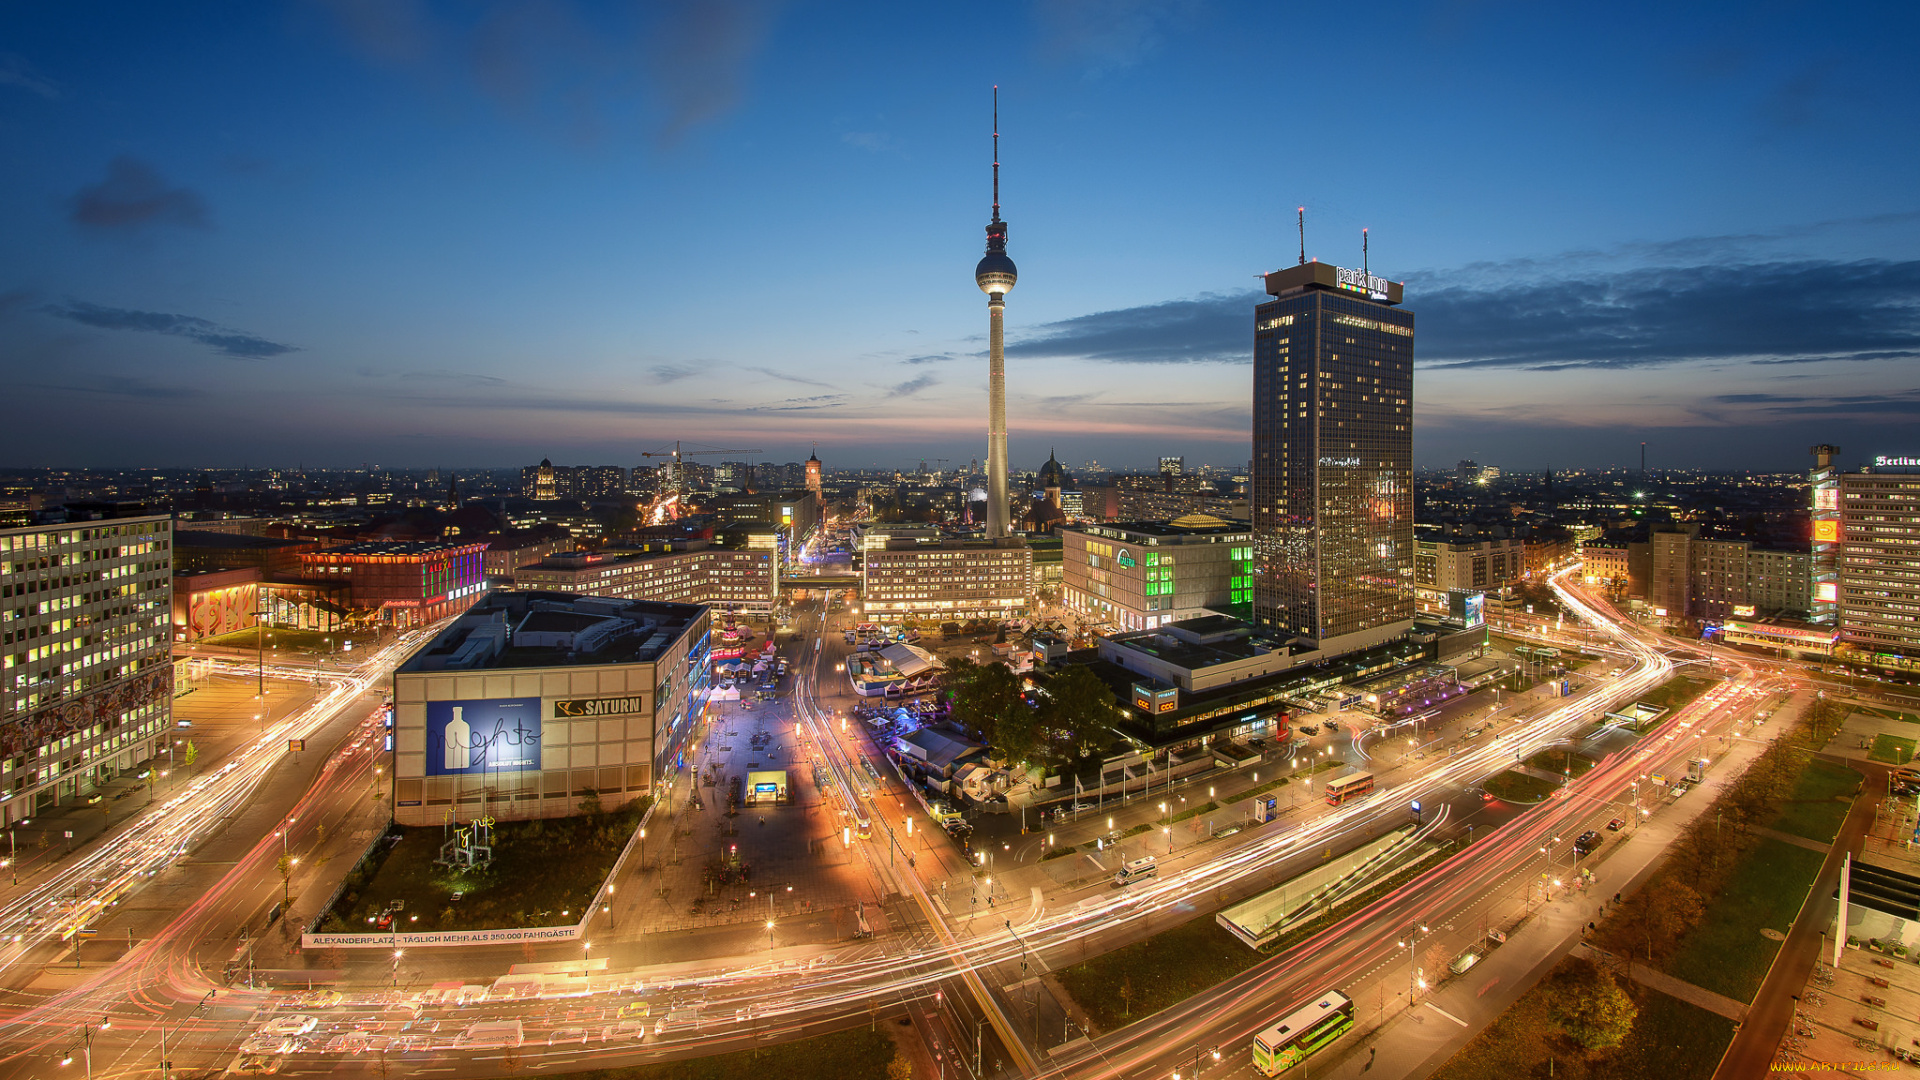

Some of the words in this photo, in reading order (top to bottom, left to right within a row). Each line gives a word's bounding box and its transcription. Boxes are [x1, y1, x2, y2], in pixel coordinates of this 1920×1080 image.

[1336, 266, 1367, 288] park
[1367, 271, 1388, 293] inn
[585, 698, 640, 715] SATURN
[1137, 698, 1150, 710] CCC
[1160, 702, 1174, 711] CCC
[523, 929, 575, 939] FAHRGÄSTE
